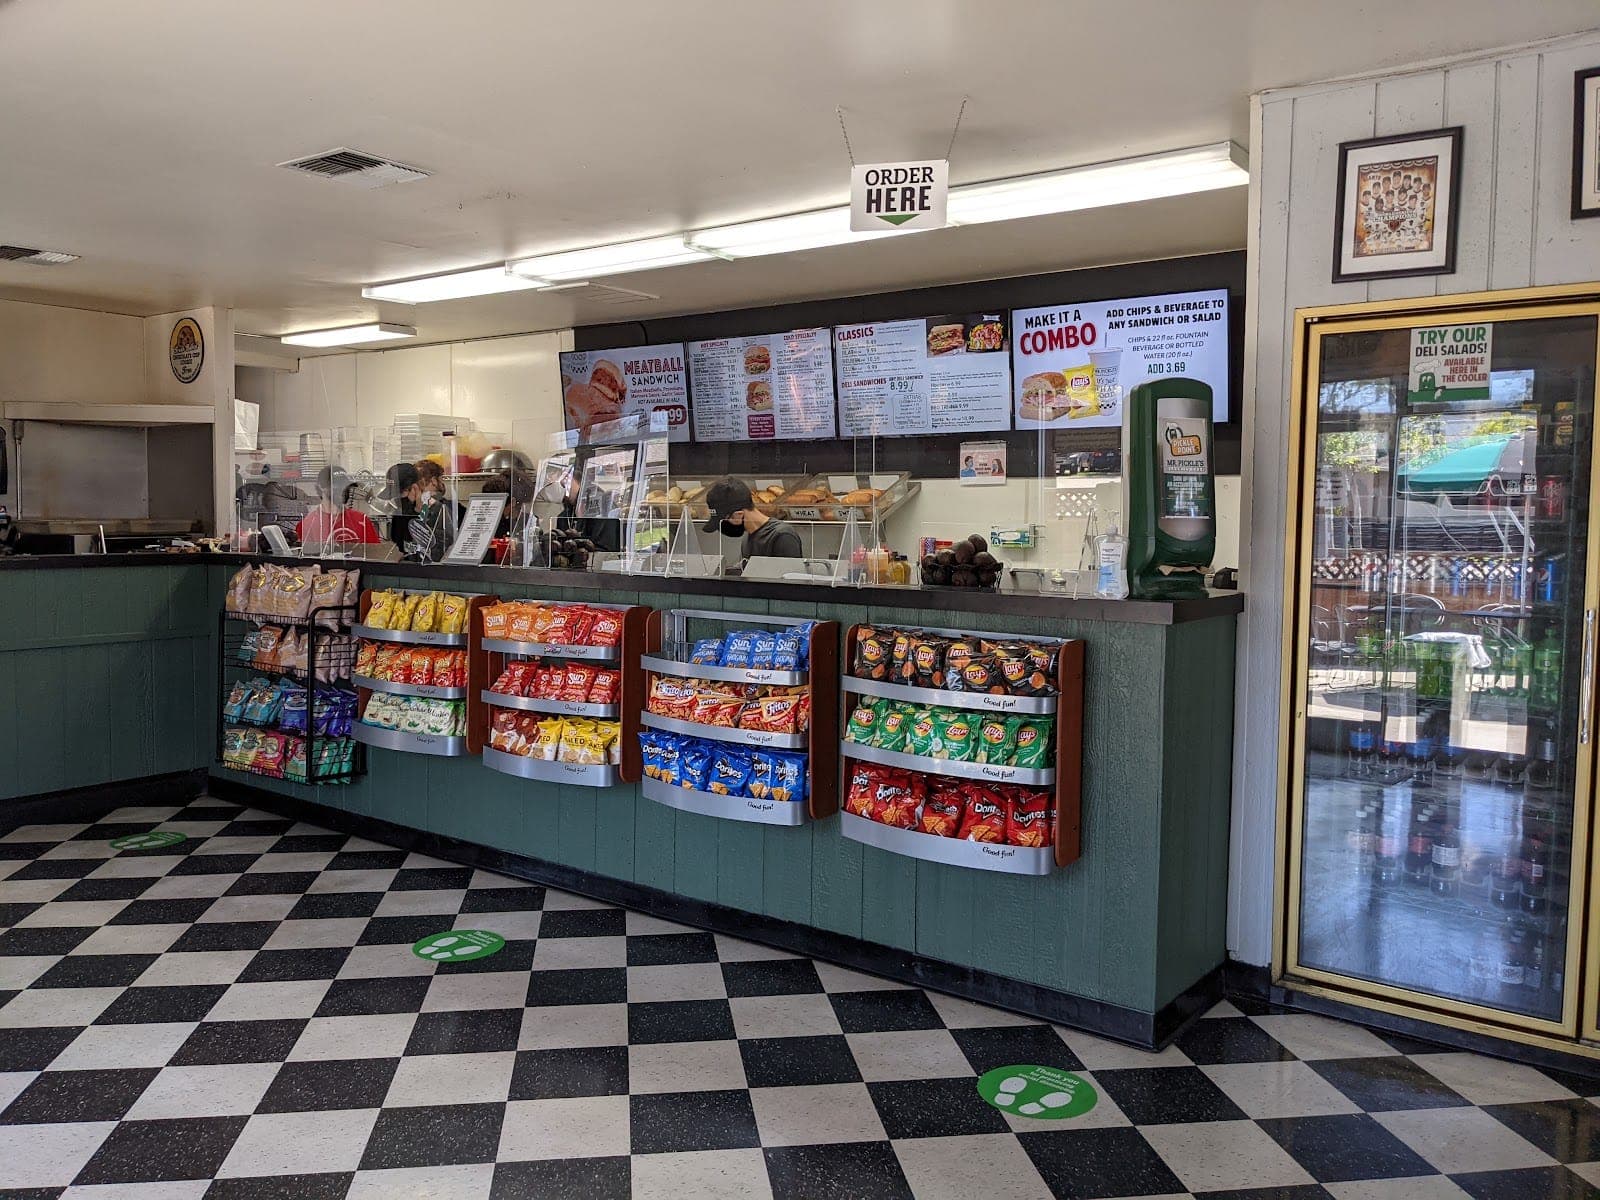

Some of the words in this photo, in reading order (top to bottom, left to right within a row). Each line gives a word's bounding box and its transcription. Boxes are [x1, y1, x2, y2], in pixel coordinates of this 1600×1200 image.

[865, 167, 934, 186] ORDER
[866, 186, 932, 213] HERE
[1106, 309, 1124, 318] ADD
[1127, 306, 1151, 316] CHIPS
[1154, 305, 1161, 314] &
[1164, 301, 1209, 312] BEVERAGE
[1212, 300, 1224, 309] TO
[1024, 313, 1056, 329] MAKE
[1058, 311, 1069, 323] IT
[1073, 309, 1081, 321] A
[1108, 321, 1125, 330] ANY
[1128, 317, 1174, 328] SANDWICH
[1177, 315, 1190, 324] OR
[1192, 312, 1221, 322] SALAD
[838, 326, 874, 341] CLASSICS
[1020, 322, 1097, 355] COMBO
[1175, 331, 1209, 340] FOUNTAIN
[1418, 329, 1448, 345] TRY
[1452, 326, 1486, 343] OUR
[1132, 343, 1164, 352] BEVERAGE
[1175, 340, 1204, 348] BOTTLED
[1415, 345, 1438, 357] DELI
[1441, 342, 1488, 356] SALADS!
[623, 356, 684, 375] MEATBALL
[1148, 363, 1163, 375] ADD
[1166, 361, 1186, 373] 3.69
[1444, 357, 1485, 367] AVAILABLE
[1449, 366, 1468, 374] HERE
[1470, 365, 1478, 373] IN
[631, 374, 680, 386] SANDWICH
[853, 378, 887, 387] SANDWICHES
[1442, 374, 1456, 383] THE
[1457, 372, 1488, 382] COOLER
[890, 381, 909, 391] 8.99
[1173, 439, 1194, 447] PICKLE
[597, 620, 615, 631] Sun
[730, 638, 750, 650] Sun
[754, 640, 774, 652] Sun
[776, 639, 796, 651] Sun
[568, 672, 585, 683] Sun
[746, 672, 760, 680] Good
[761, 673, 772, 682] fun!
[766, 701, 790, 715] Fritos
[984, 697, 1001, 707] Good
[1002, 699, 1016, 709] fun!
[747, 733, 761, 742] Good
[761, 735, 773, 744] fun!
[715, 760, 743, 778] Doritos
[983, 767, 1000, 777] Good
[1001, 770, 1015, 779] fun!
[747, 801, 762, 810] Good
[762, 803, 774, 812] fun!
[1013, 810, 1046, 823] Doritos
[982, 846, 1000, 856] Good
[1000, 849, 1015, 859] fun!
[1035, 1067, 1063, 1080] Thank
[1062, 1075, 1080, 1085] you
